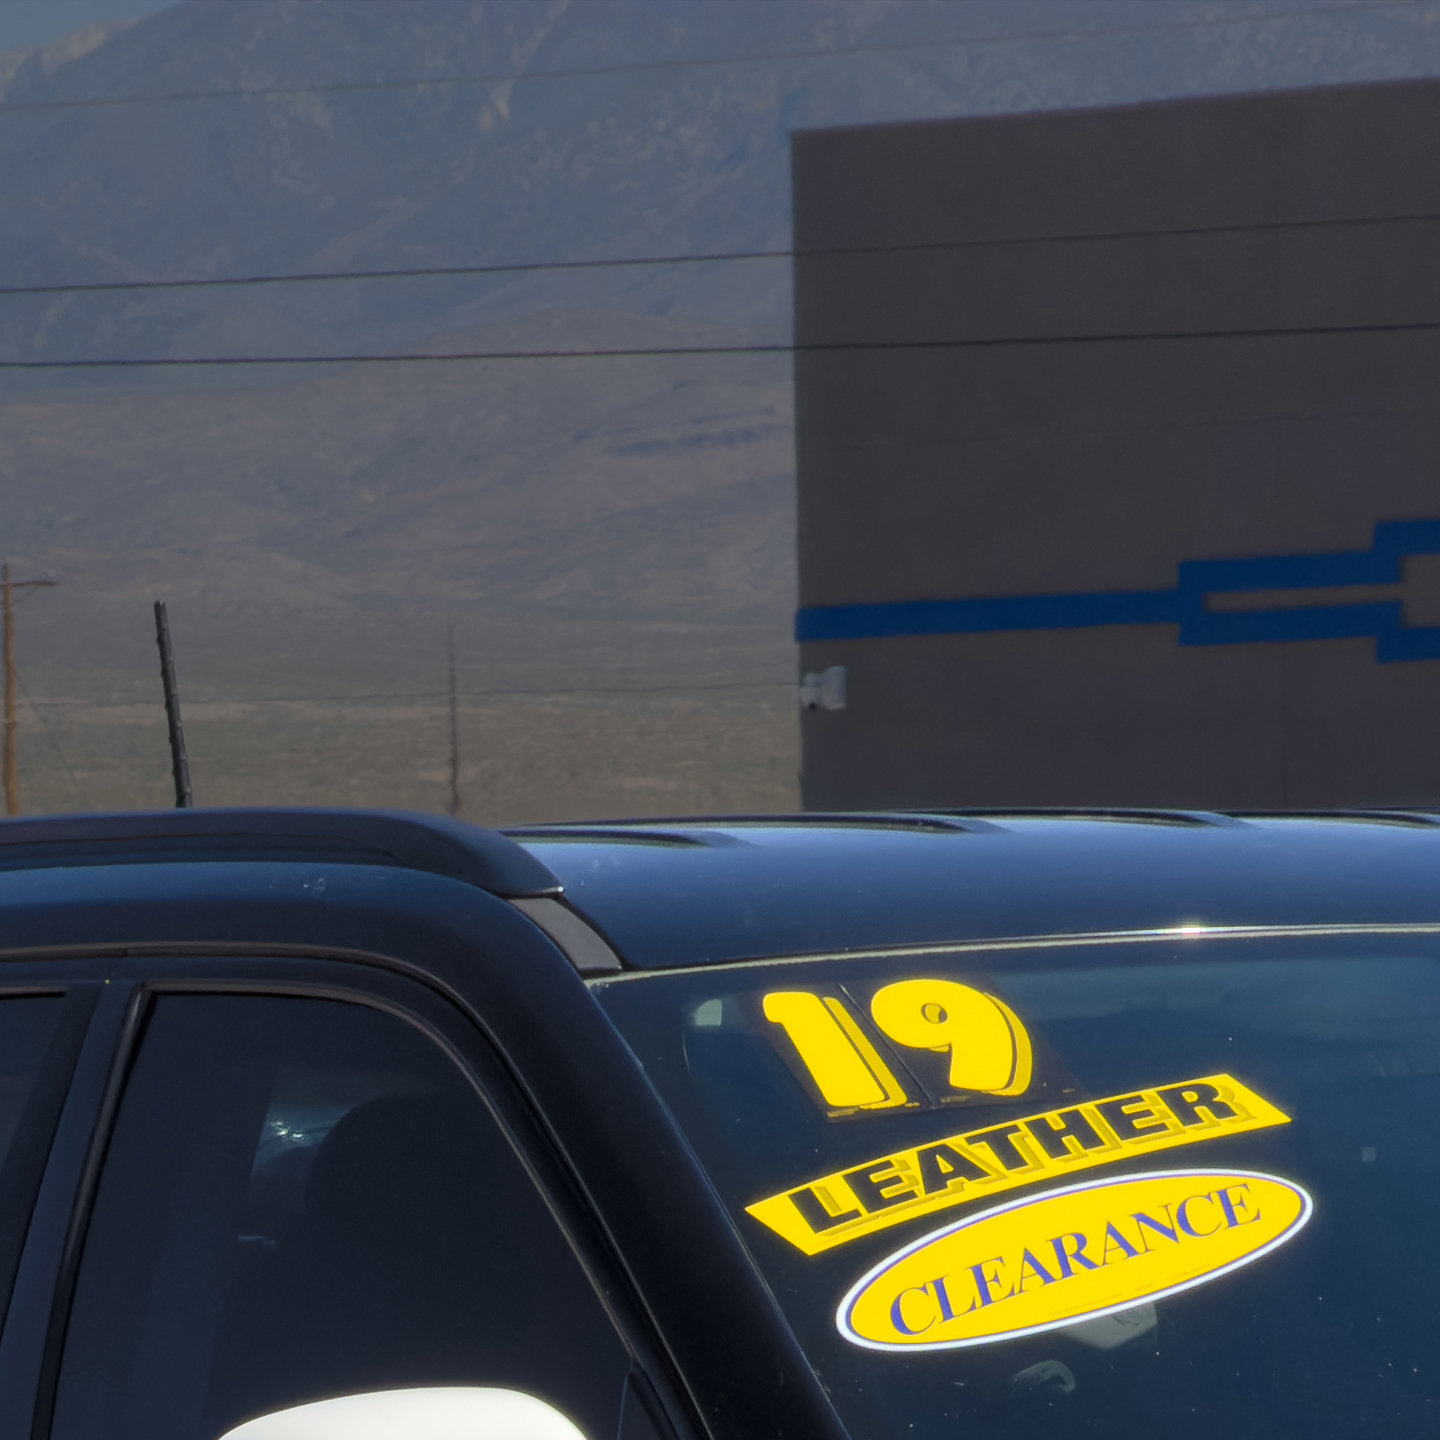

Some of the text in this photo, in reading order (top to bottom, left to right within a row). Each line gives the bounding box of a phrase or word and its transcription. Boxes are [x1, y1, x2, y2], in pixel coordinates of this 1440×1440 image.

[762, 978, 1033, 1107] 19
[787, 1081, 1250, 1236] LEATHER
[889, 1182, 1263, 1336] CLEARANCE
